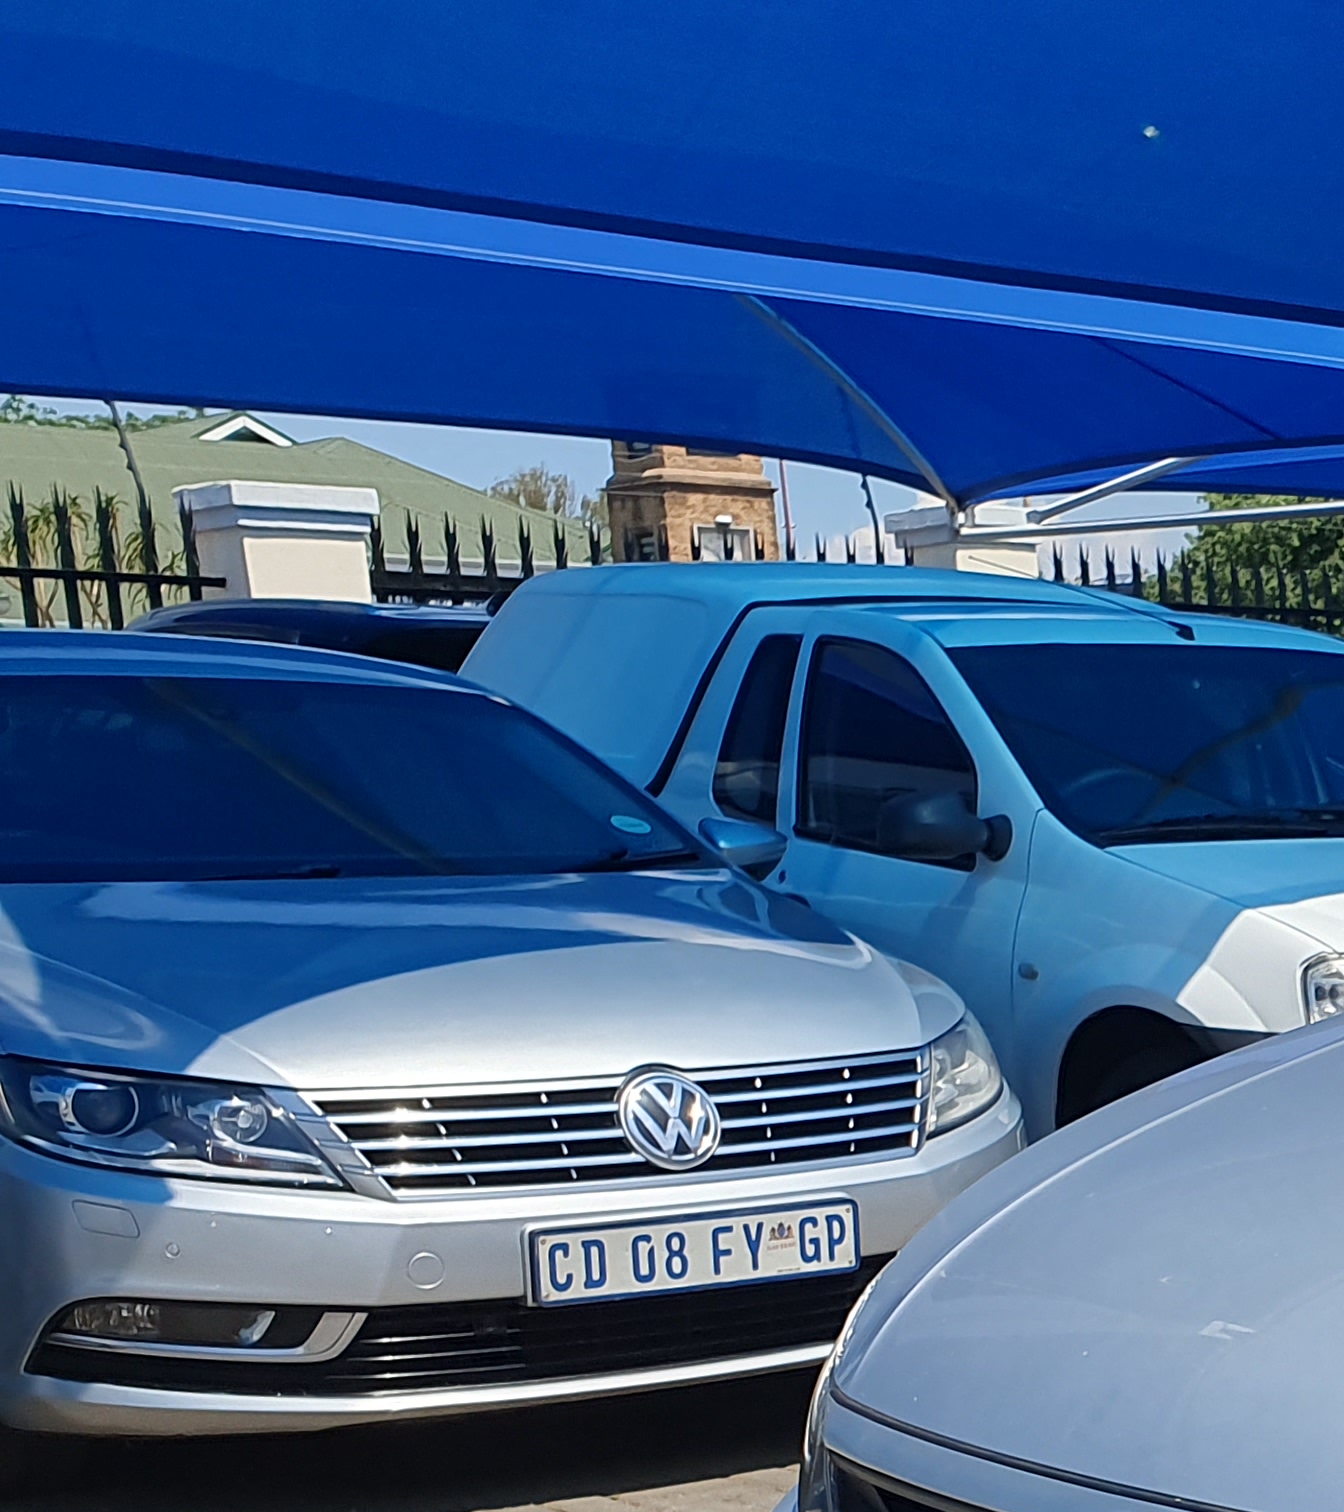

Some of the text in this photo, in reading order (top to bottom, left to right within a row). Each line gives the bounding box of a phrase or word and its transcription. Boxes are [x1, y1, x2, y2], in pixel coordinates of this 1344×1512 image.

[622, 1071, 719, 1166] VW
[547, 1213, 846, 1293] CD 08 FY GP
